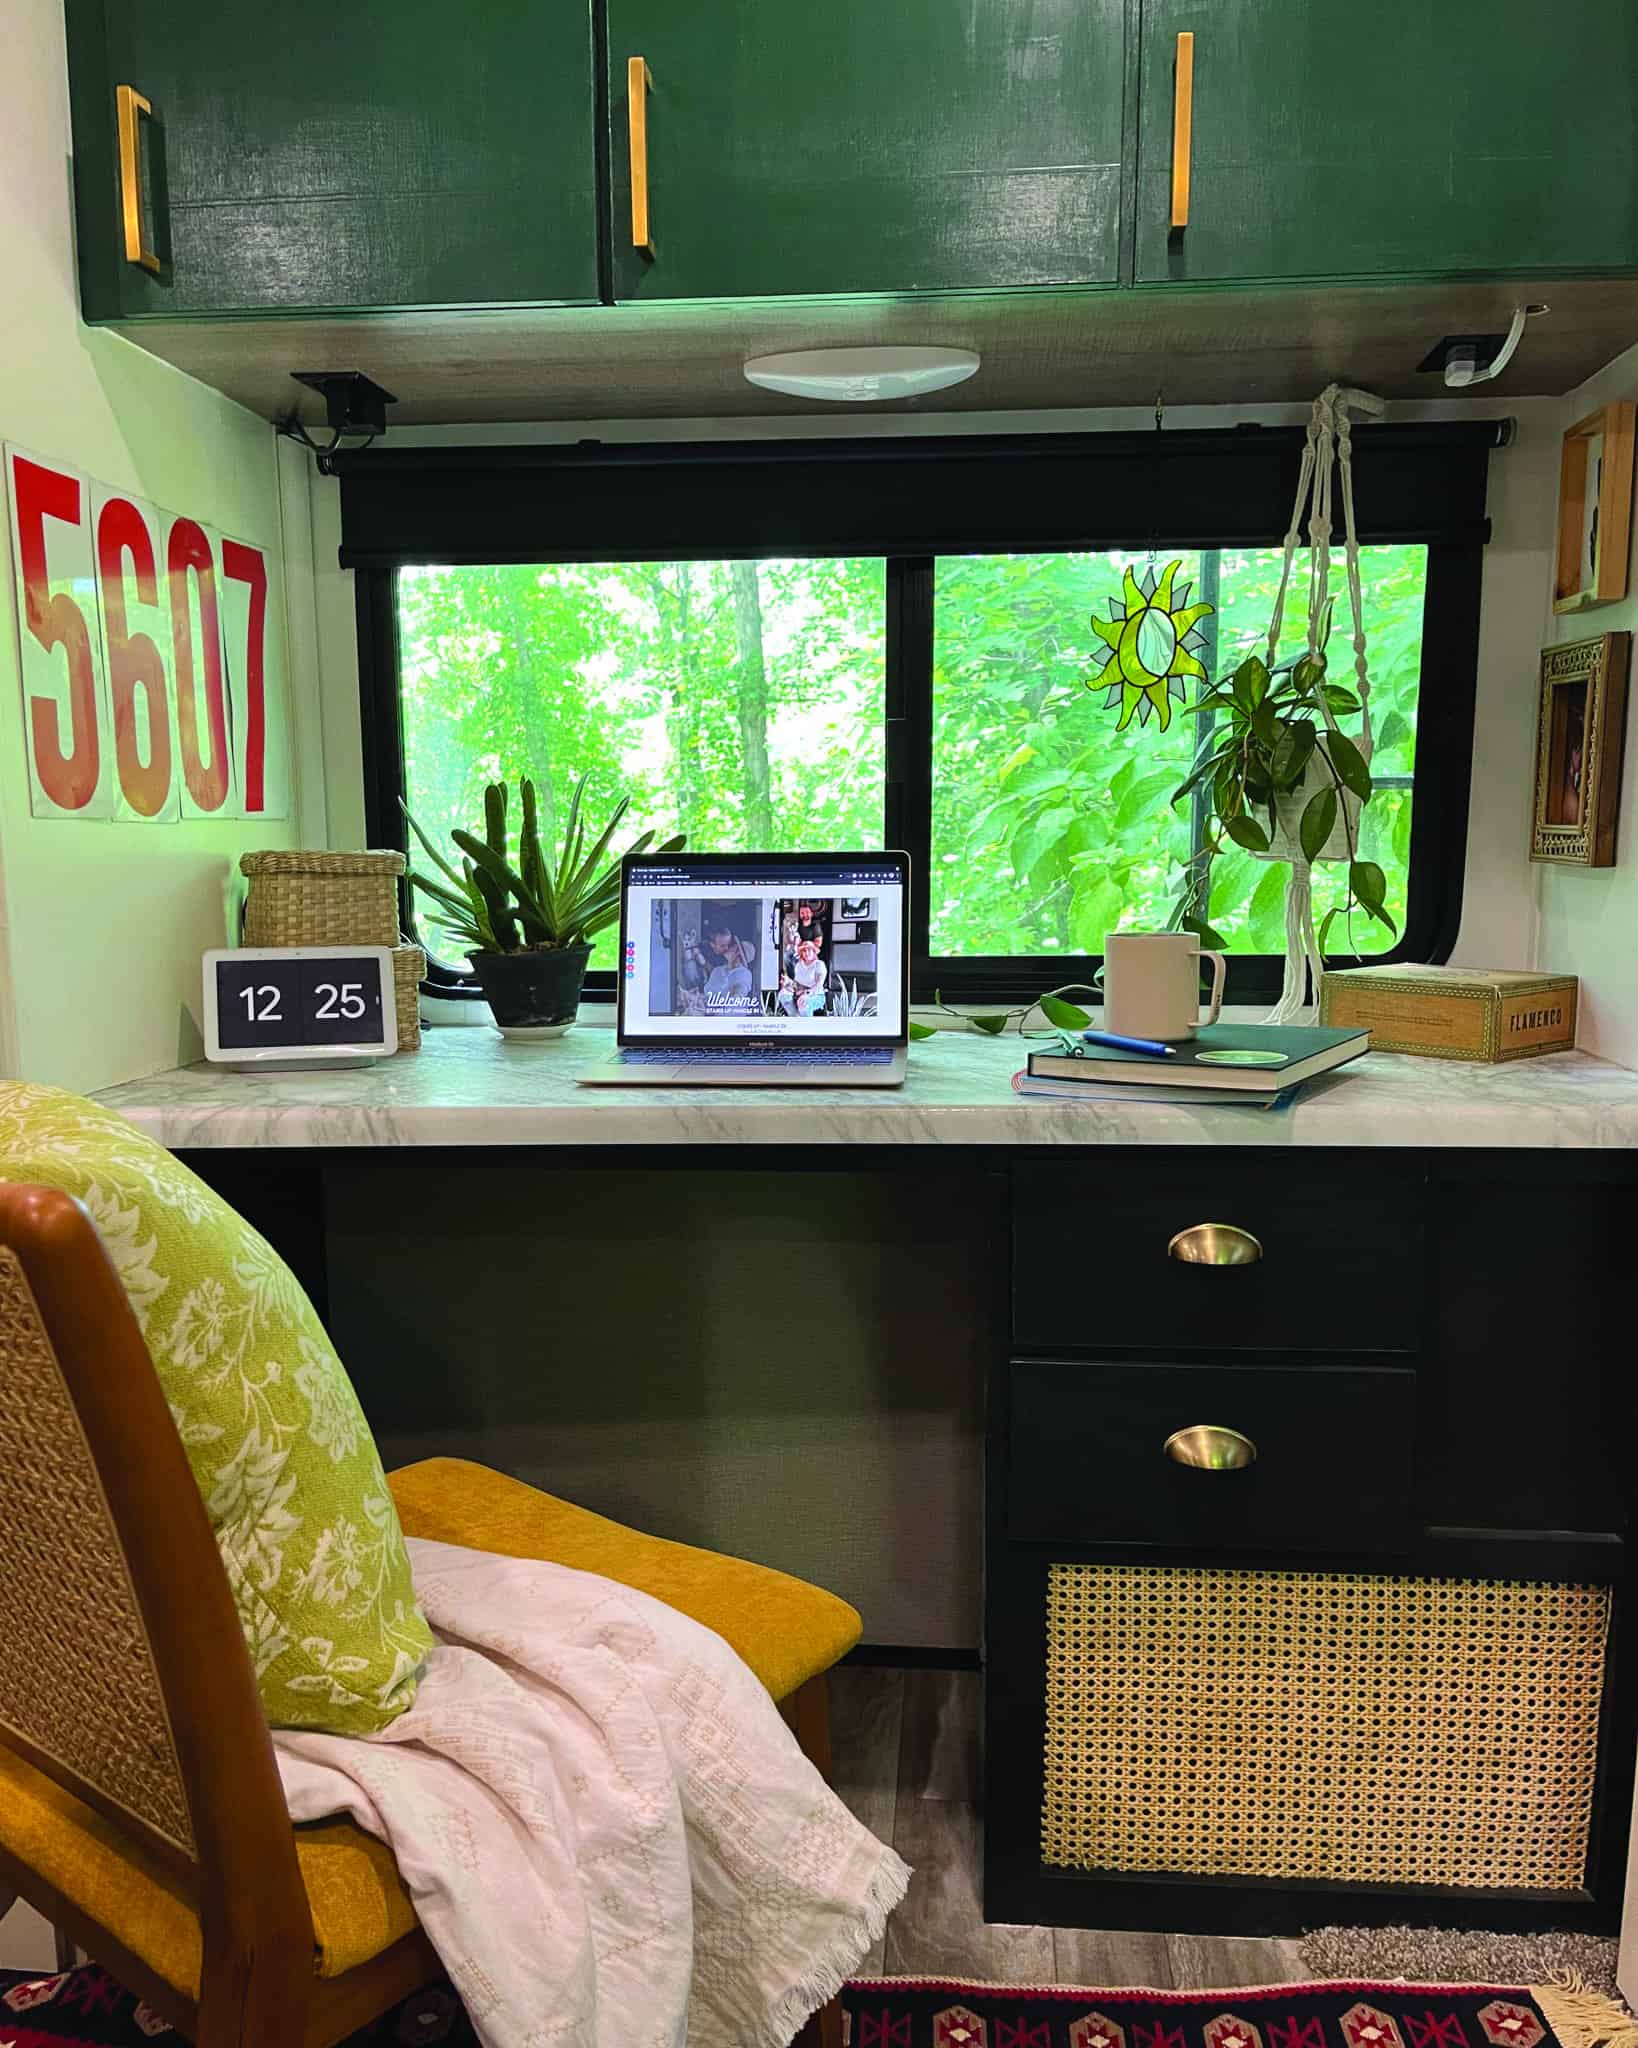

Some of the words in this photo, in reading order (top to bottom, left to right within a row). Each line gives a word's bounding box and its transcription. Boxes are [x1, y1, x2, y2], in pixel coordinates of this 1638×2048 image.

[13, 454, 267, 817] 5607
[239, 985, 283, 1021] 12
[314, 983, 366, 1019] 25
[706, 991, 760, 1007] Welcome
[1510, 1008, 1562, 1033] FLAMENCO
